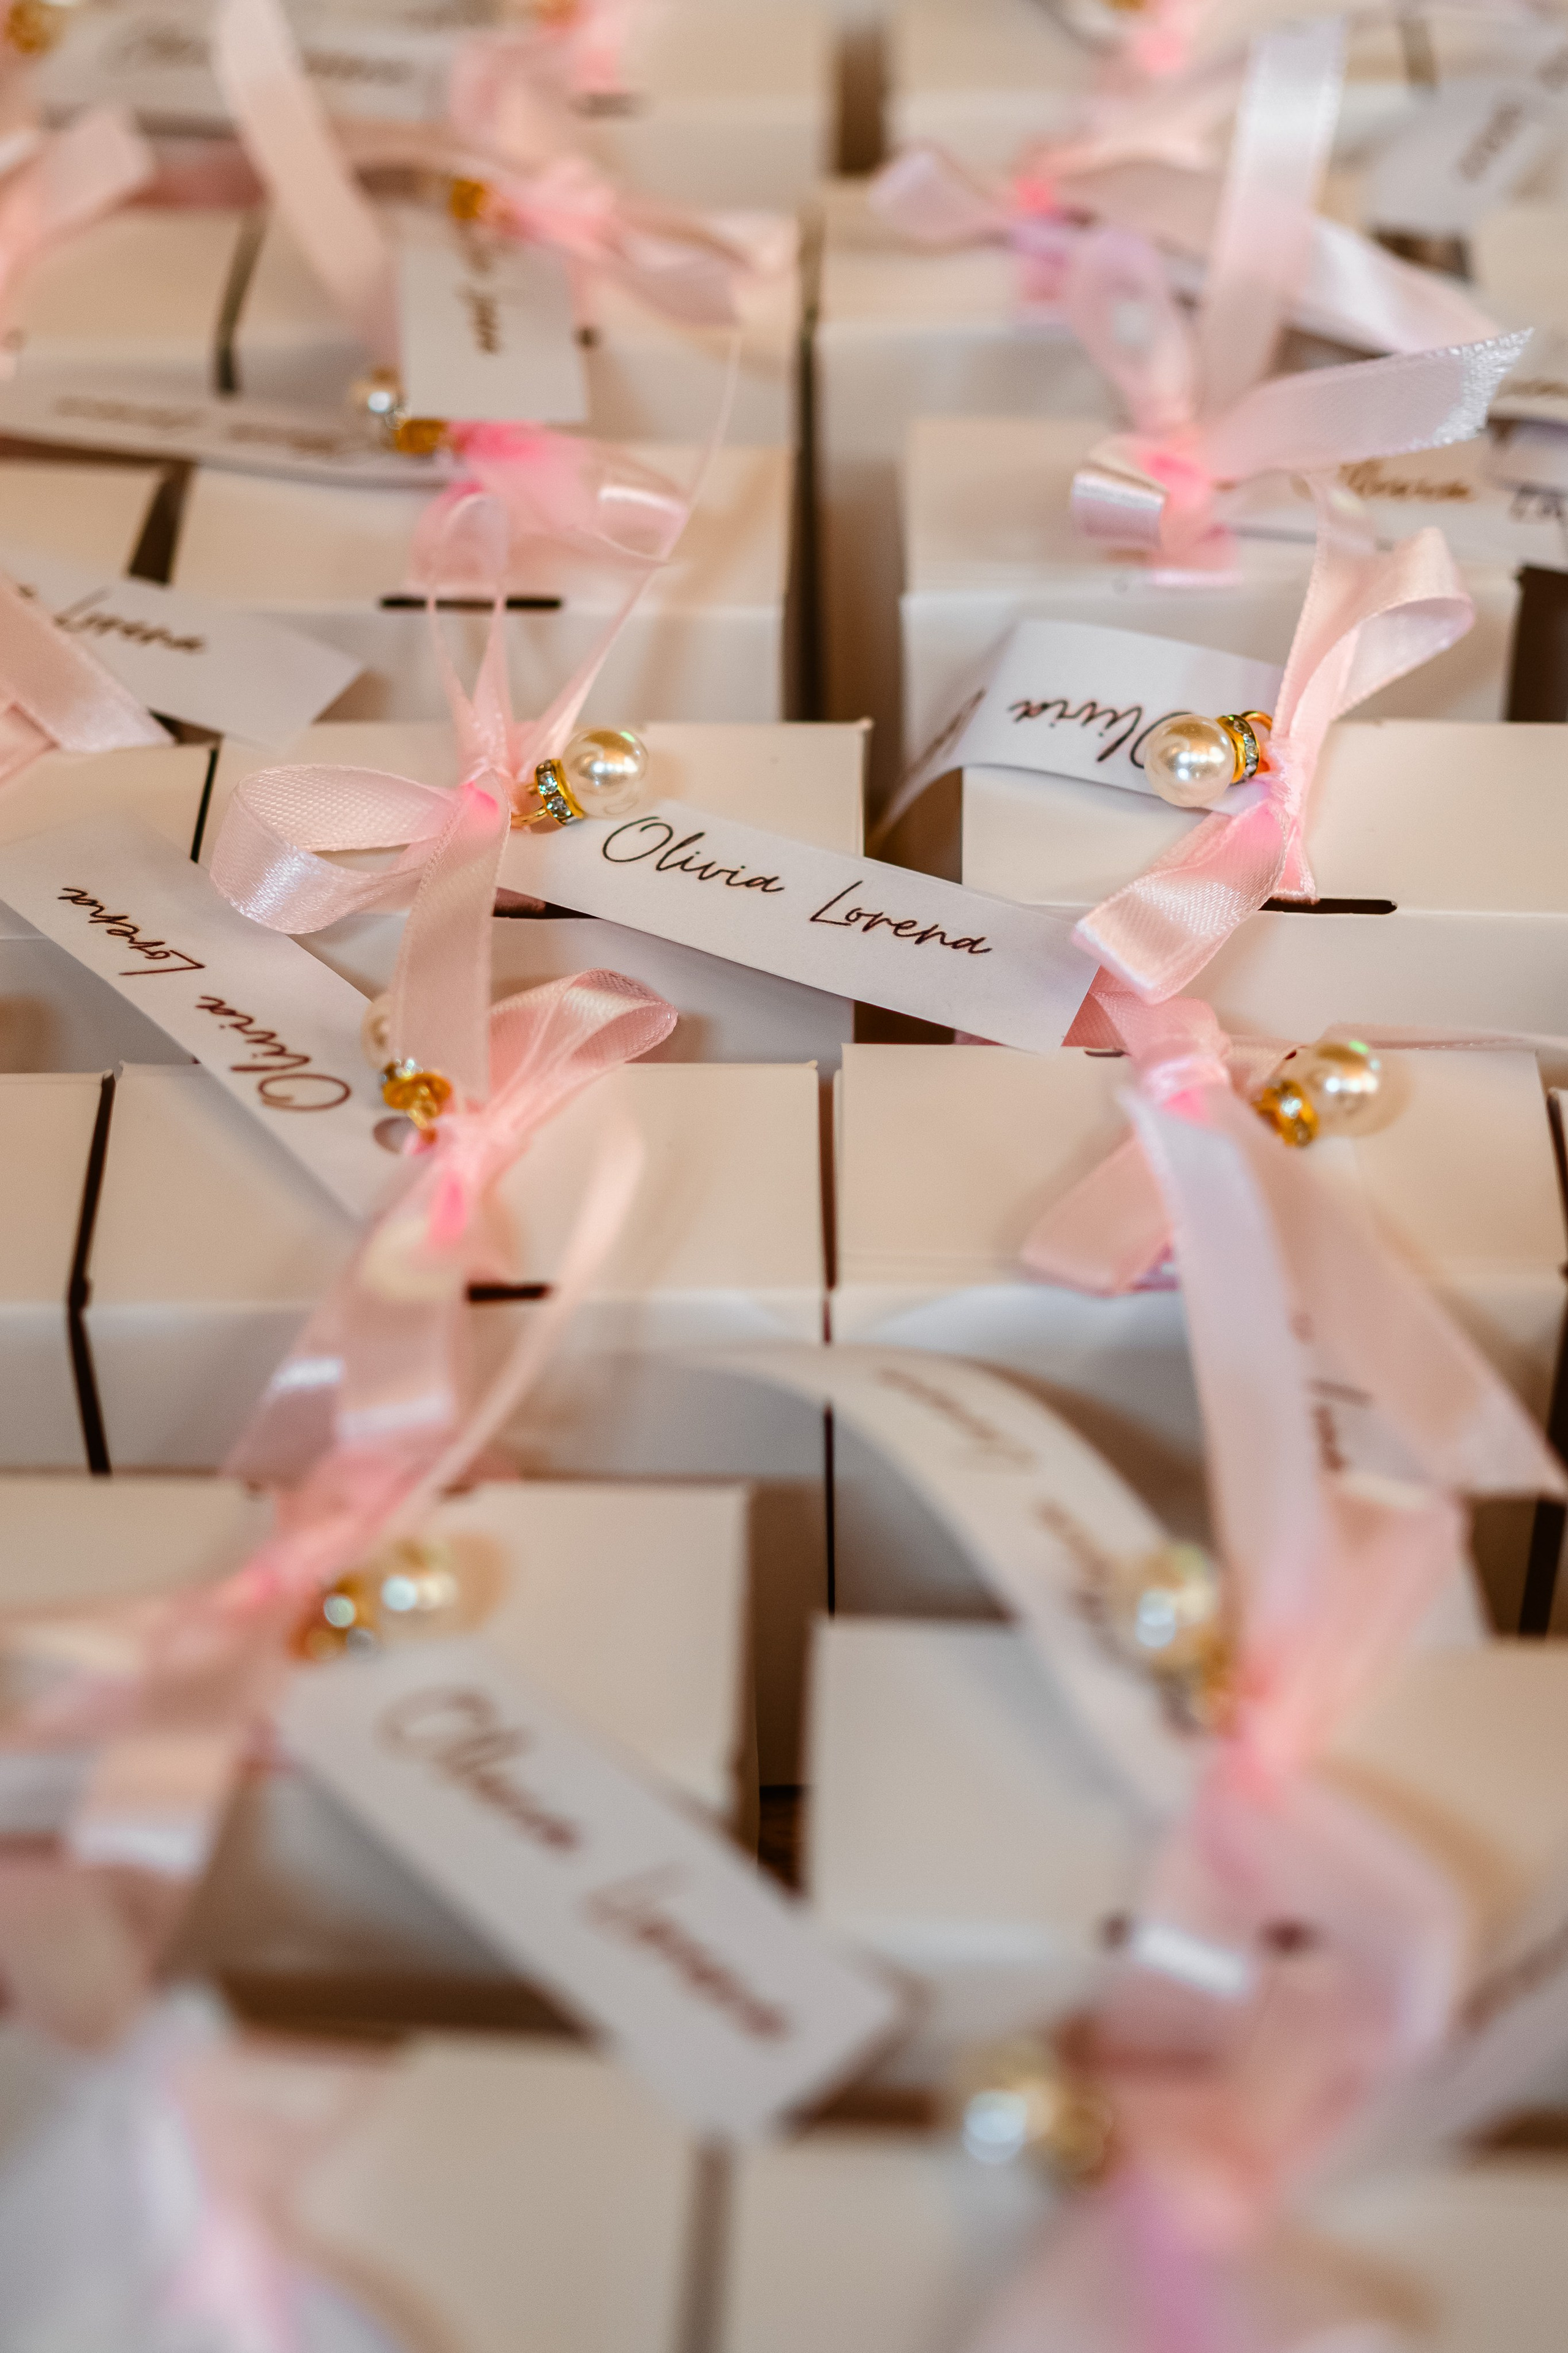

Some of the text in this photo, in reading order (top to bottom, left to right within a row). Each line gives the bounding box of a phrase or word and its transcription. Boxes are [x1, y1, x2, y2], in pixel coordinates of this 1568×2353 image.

[601, 816, 992, 955] Olivia Lorena
[57, 887, 352, 1113] Olivia Lorena
